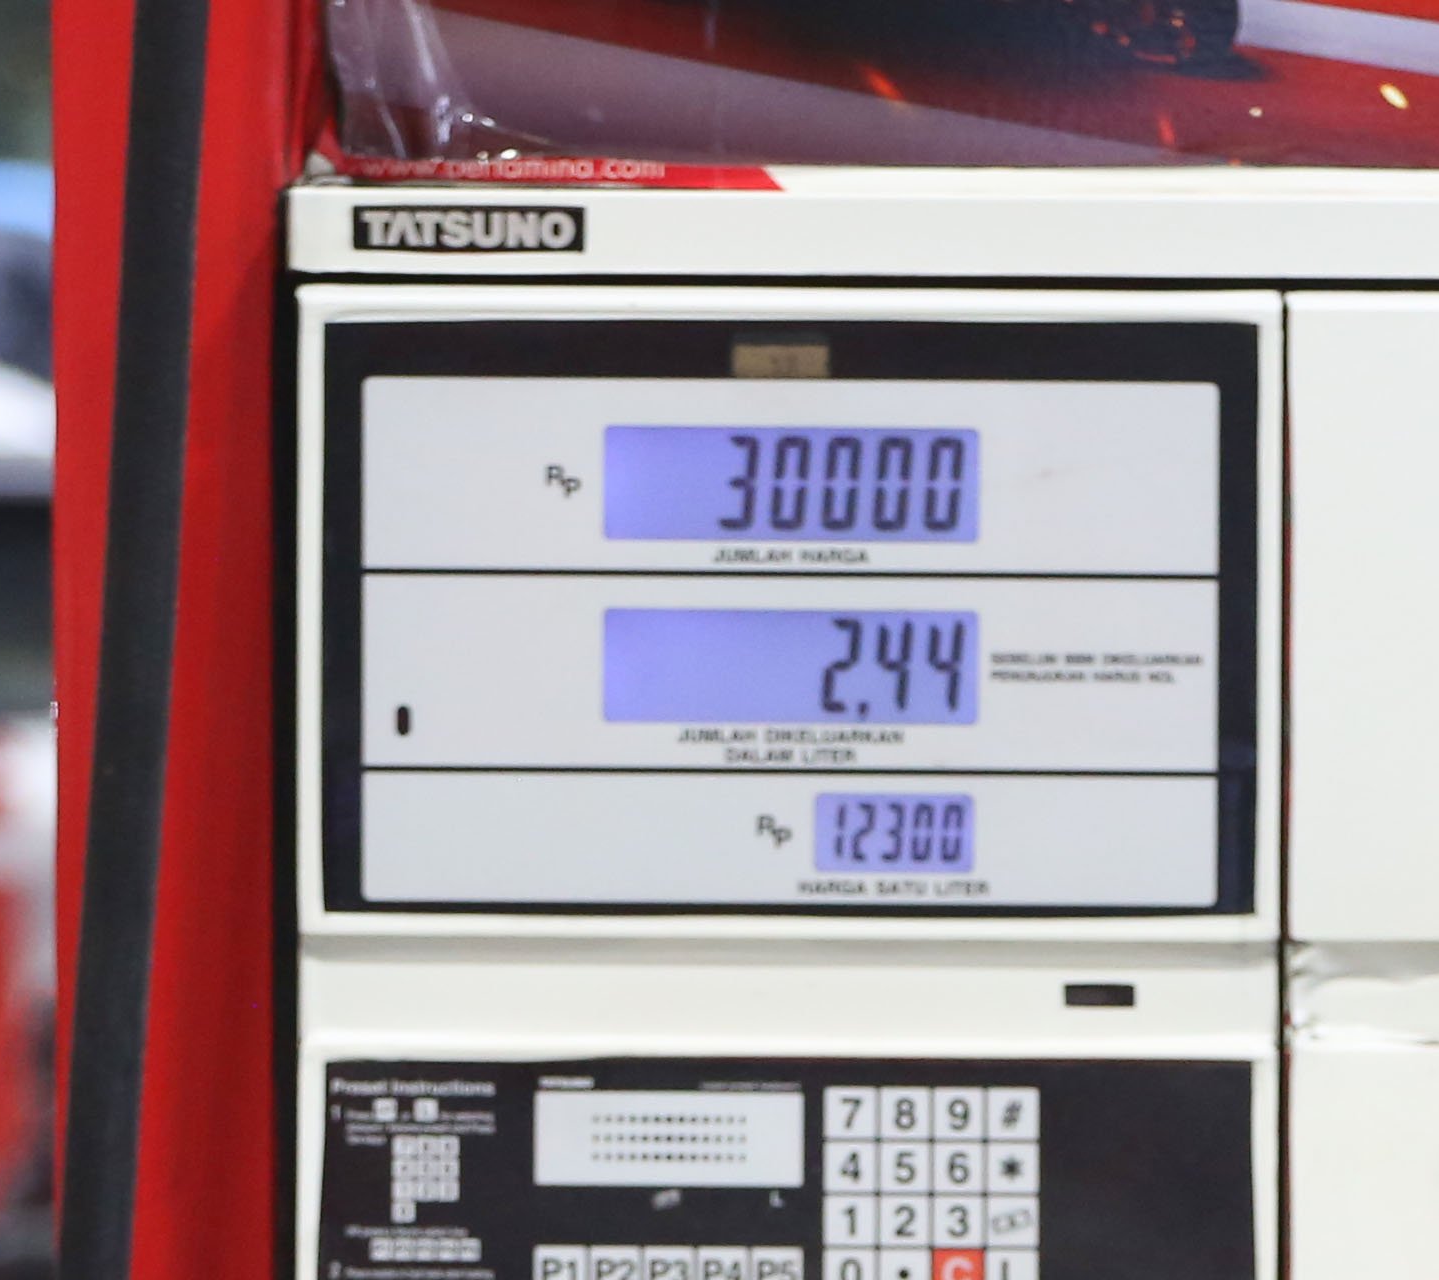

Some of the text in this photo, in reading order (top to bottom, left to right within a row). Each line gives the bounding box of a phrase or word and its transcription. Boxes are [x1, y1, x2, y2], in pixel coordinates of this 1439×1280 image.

[362, 212, 576, 247] TATSUNO
[545, 466, 581, 496] Rp
[718, 436, 965, 530] 30000
[756, 814, 792, 849] Rp
[834, 802, 965, 863] 12300
[842, 1098, 862, 1129] 7
[895, 1098, 915, 1129] 8
[948, 1098, 969, 1130] 9
[841, 1151, 969, 1184] 4 5 6
[842, 1205, 969, 1237] 1 2 3
